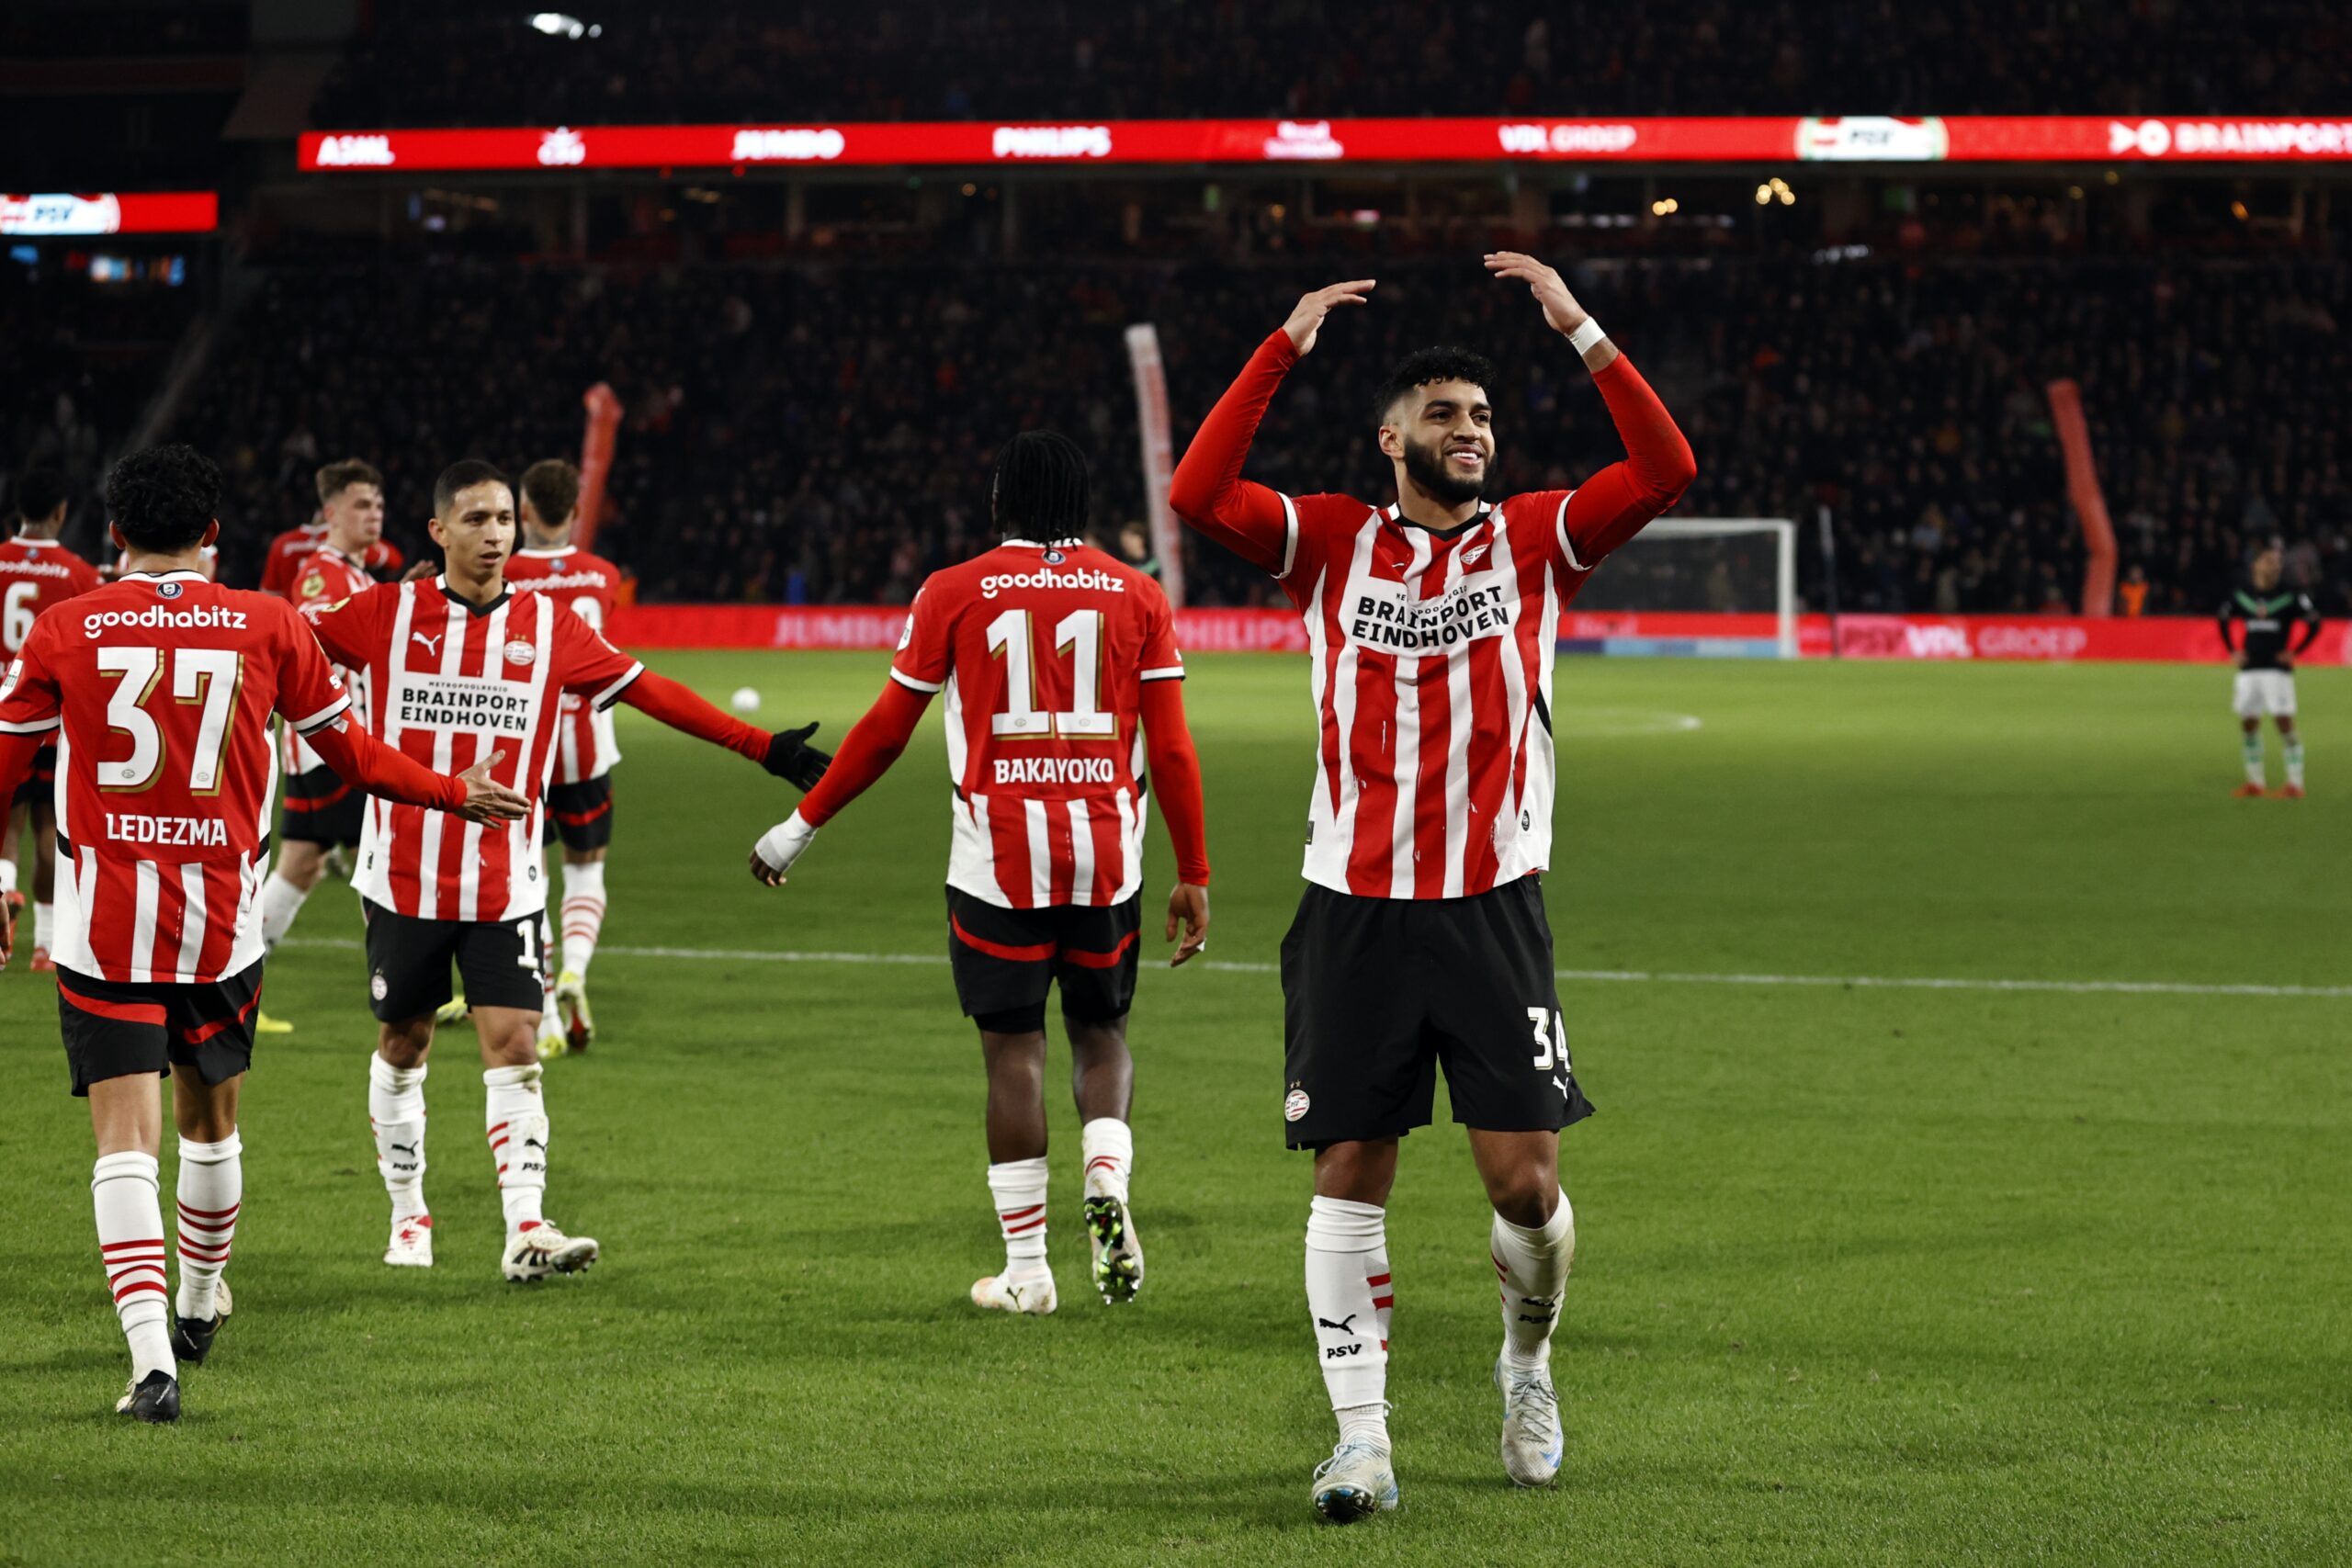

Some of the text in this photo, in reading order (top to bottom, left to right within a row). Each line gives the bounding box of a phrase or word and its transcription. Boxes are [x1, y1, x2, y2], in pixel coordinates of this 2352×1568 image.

[980, 569, 1125, 599] goodhabitz
[3, 581, 40, 653] 6
[85, 604, 247, 639] goodhabitz
[1357, 585, 1501, 629] BRAINPORT
[1351, 607, 1509, 649] EINDHOVEN
[986, 609, 1119, 740] 11
[402, 687, 529, 713] BRAINPORT
[97, 646, 244, 796] 37
[400, 706, 527, 731] EINDHOVEN
[993, 758, 1114, 784] BAKAYOKO
[106, 813, 228, 846] LEDEZMA
[516, 919, 544, 969] 1
[1527, 1007, 1572, 1072] 34
[392, 1162, 419, 1171] PSV
[1518, 1313, 1555, 1324] PSV
[1327, 1344, 1363, 1359] PSV
